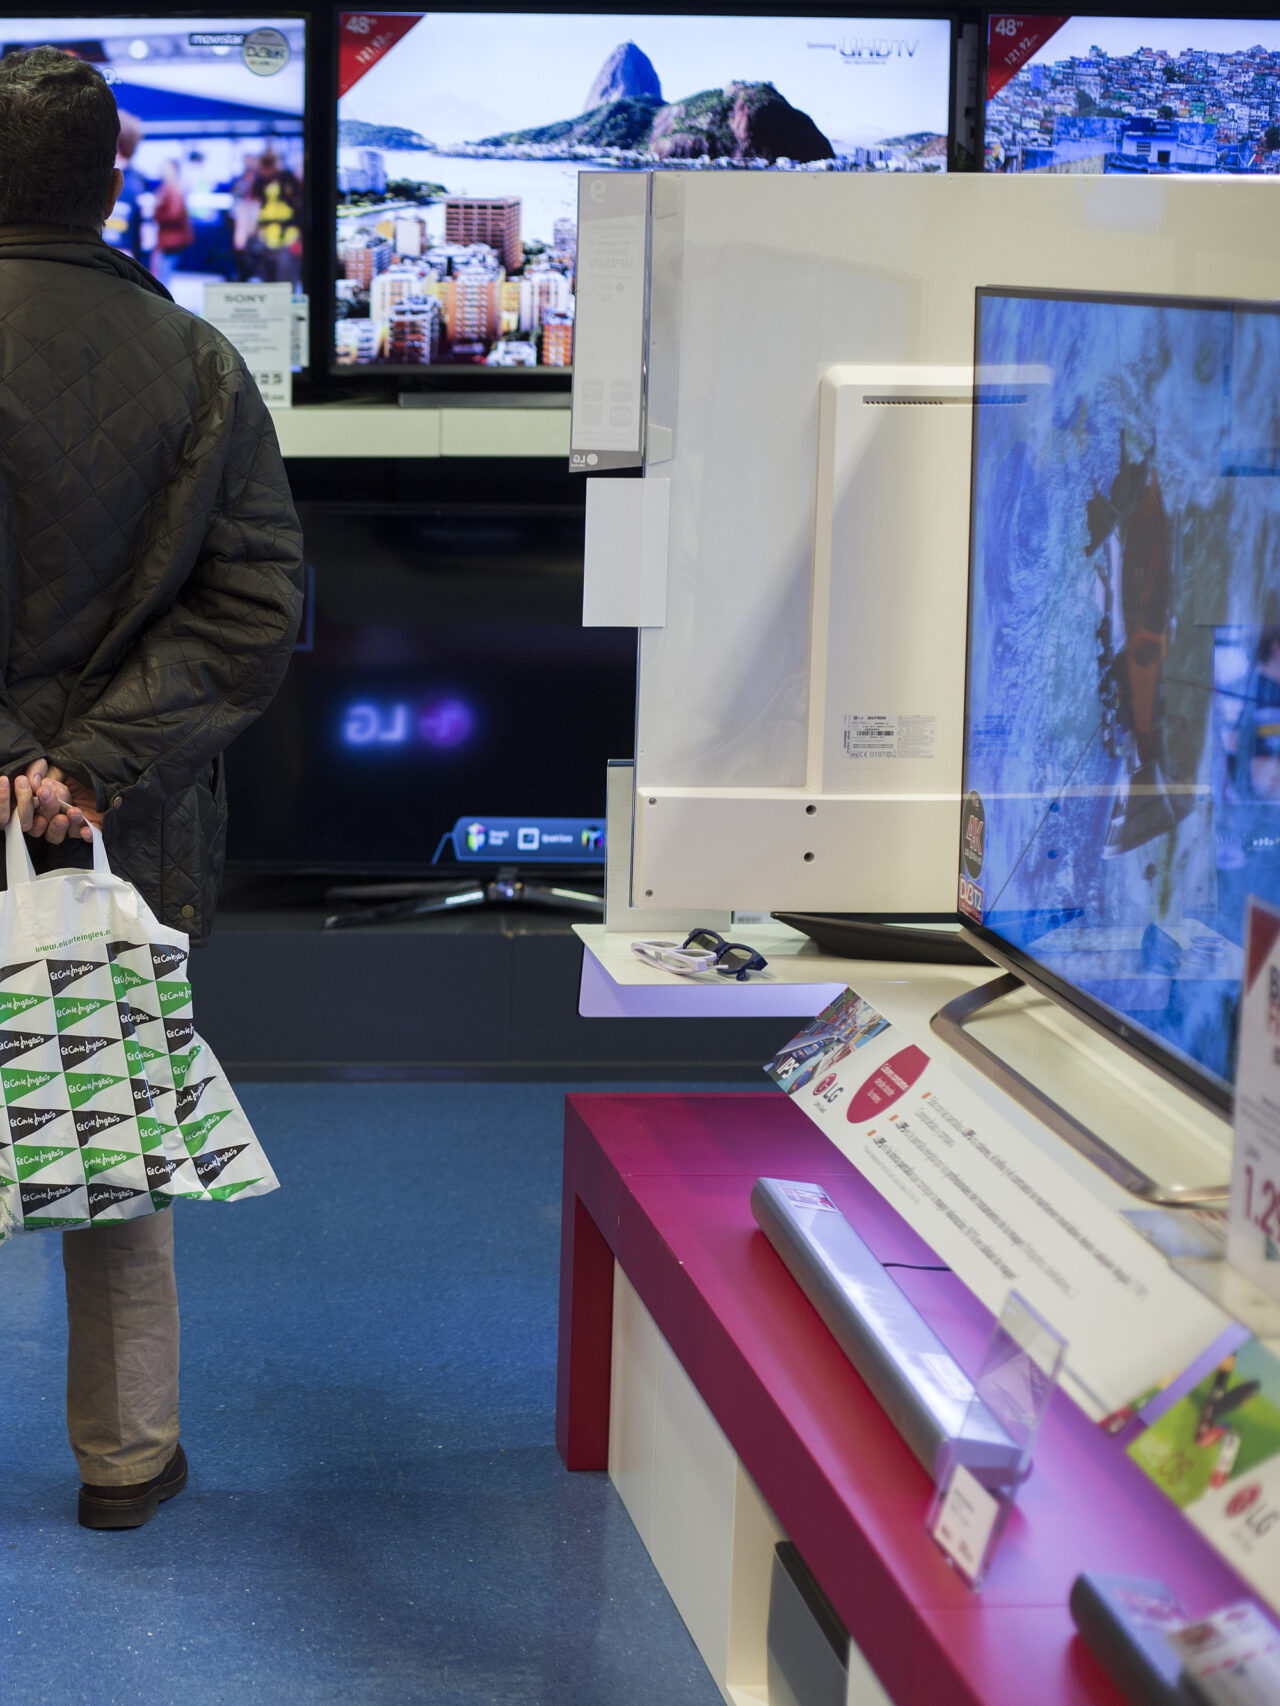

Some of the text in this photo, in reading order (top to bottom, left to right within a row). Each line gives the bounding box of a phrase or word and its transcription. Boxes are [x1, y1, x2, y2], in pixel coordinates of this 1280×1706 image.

[995, 19, 1023, 36] 48"
[225, 294, 266, 302] SONY
[50, 963, 94, 980] El Corte Inglés
[13, 996, 38, 1010] Inglés
[160, 991, 184, 1001] El Corte
[56, 1001, 100, 1018] El Corte Inglés
[166, 1030, 174, 1038] El
[3, 1040, 20, 1050] Corte
[20, 1036, 45, 1049] Inglés
[61, 1039, 108, 1056] El Corte Inglés
[776, 1057, 800, 1079] IPS
[4, 1074, 51, 1089] El Corte Inglés
[69, 1077, 114, 1093] El Corte Inglés
[822, 1082, 844, 1104] LG
[10, 1111, 56, 1127] El Corte Inglés
[84, 1121, 95, 1130] Corte
[16, 1149, 64, 1165] El Corte Inglés
[102, 1153, 127, 1166] Inglés
[30, 1191, 47, 1201] Corte
[93, 1188, 133, 1201] Corte Inglés
